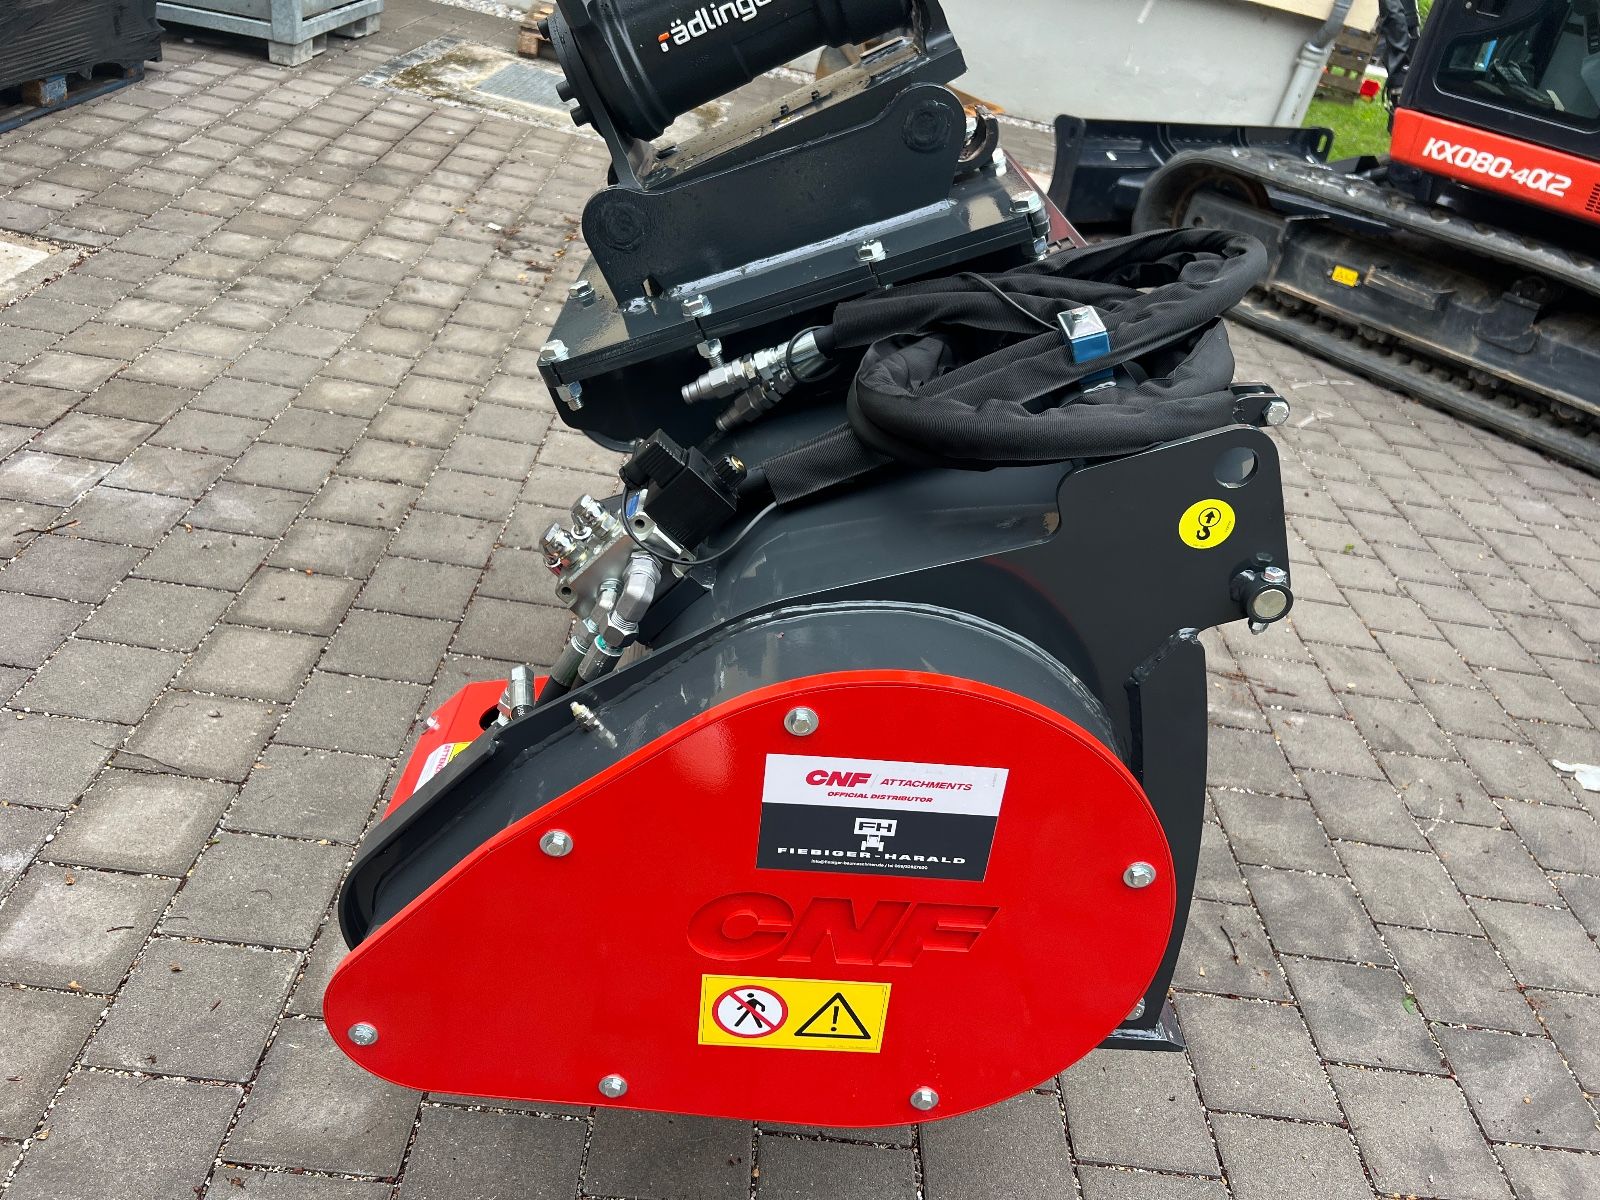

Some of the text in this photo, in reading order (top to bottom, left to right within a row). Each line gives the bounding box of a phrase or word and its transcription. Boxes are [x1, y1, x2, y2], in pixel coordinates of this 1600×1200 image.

[805, 769, 873, 788] CNF
[880, 778, 973, 791] ATTACHMENTS
[827, 791, 933, 803] OFFICIAL DISTRIBUTOR
[857, 820, 893, 834] FH
[686, 891, 1001, 967] CNF
